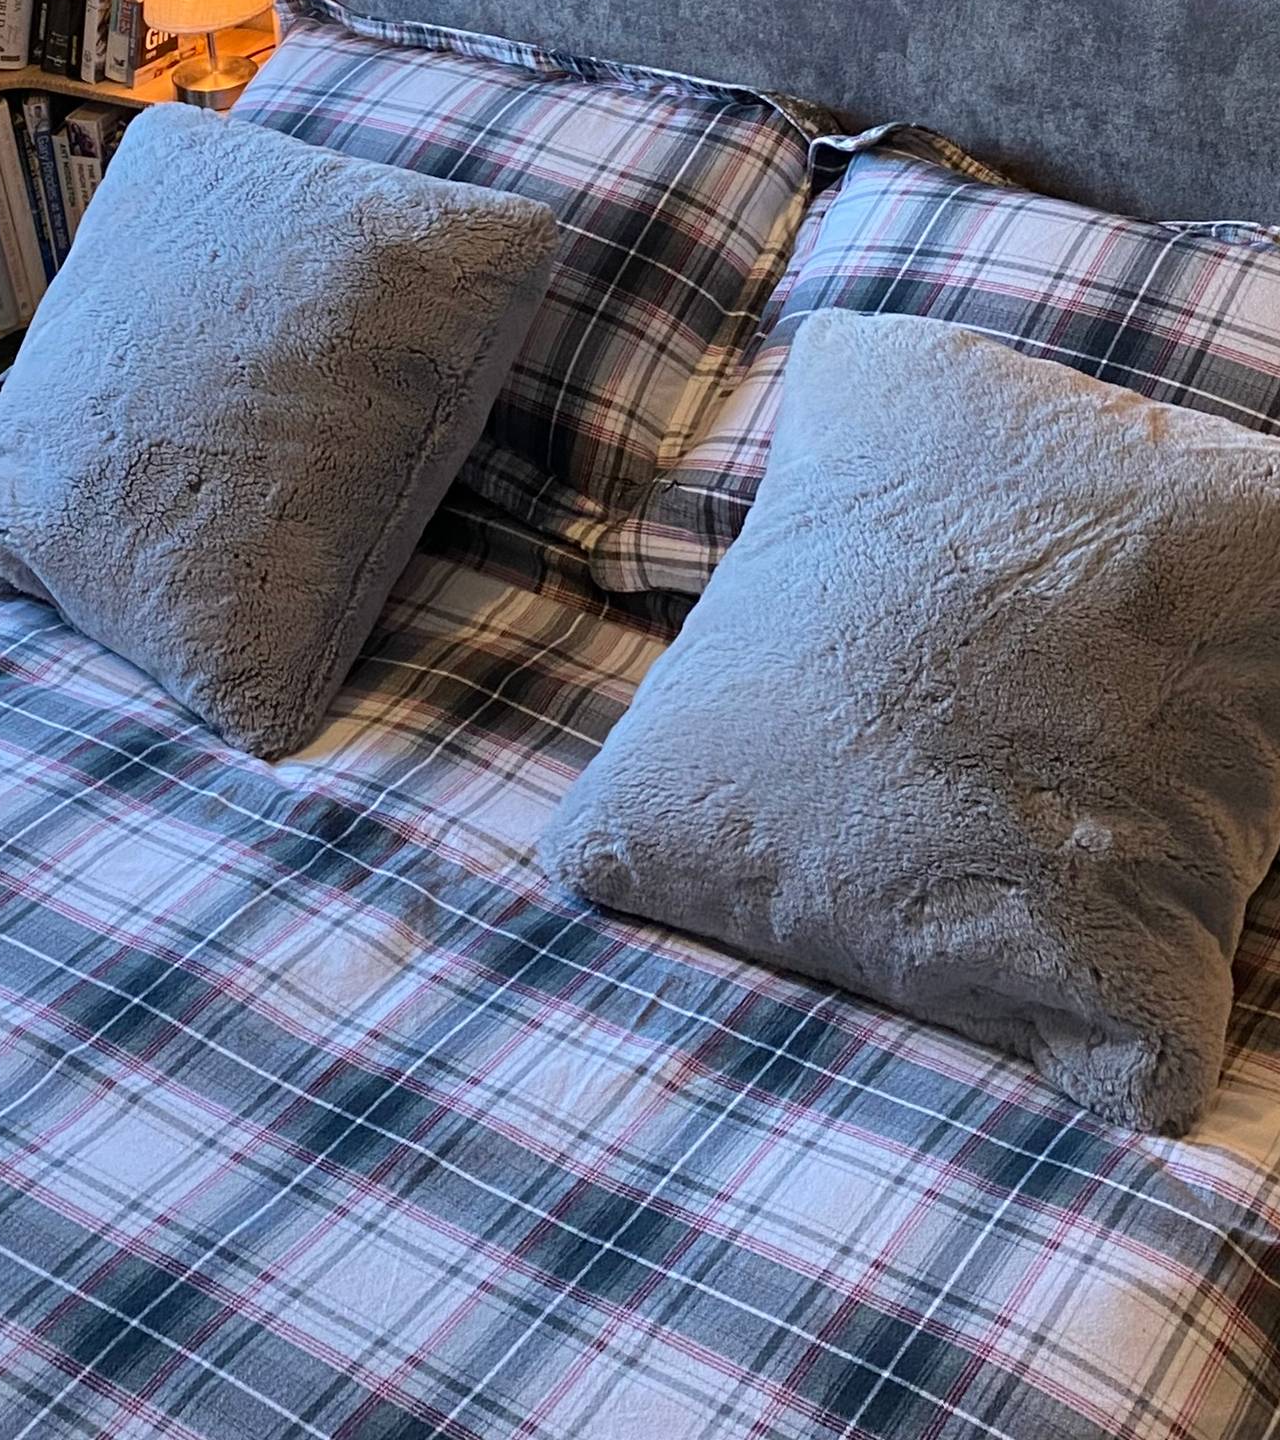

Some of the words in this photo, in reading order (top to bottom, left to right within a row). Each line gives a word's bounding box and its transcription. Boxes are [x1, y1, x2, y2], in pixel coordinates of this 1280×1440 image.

[37, 135, 51, 160] Gary
[60, 143, 69, 161] ANT
[41, 159, 59, 199] Rhodes
[63, 162, 76, 208] MIDDLETON
